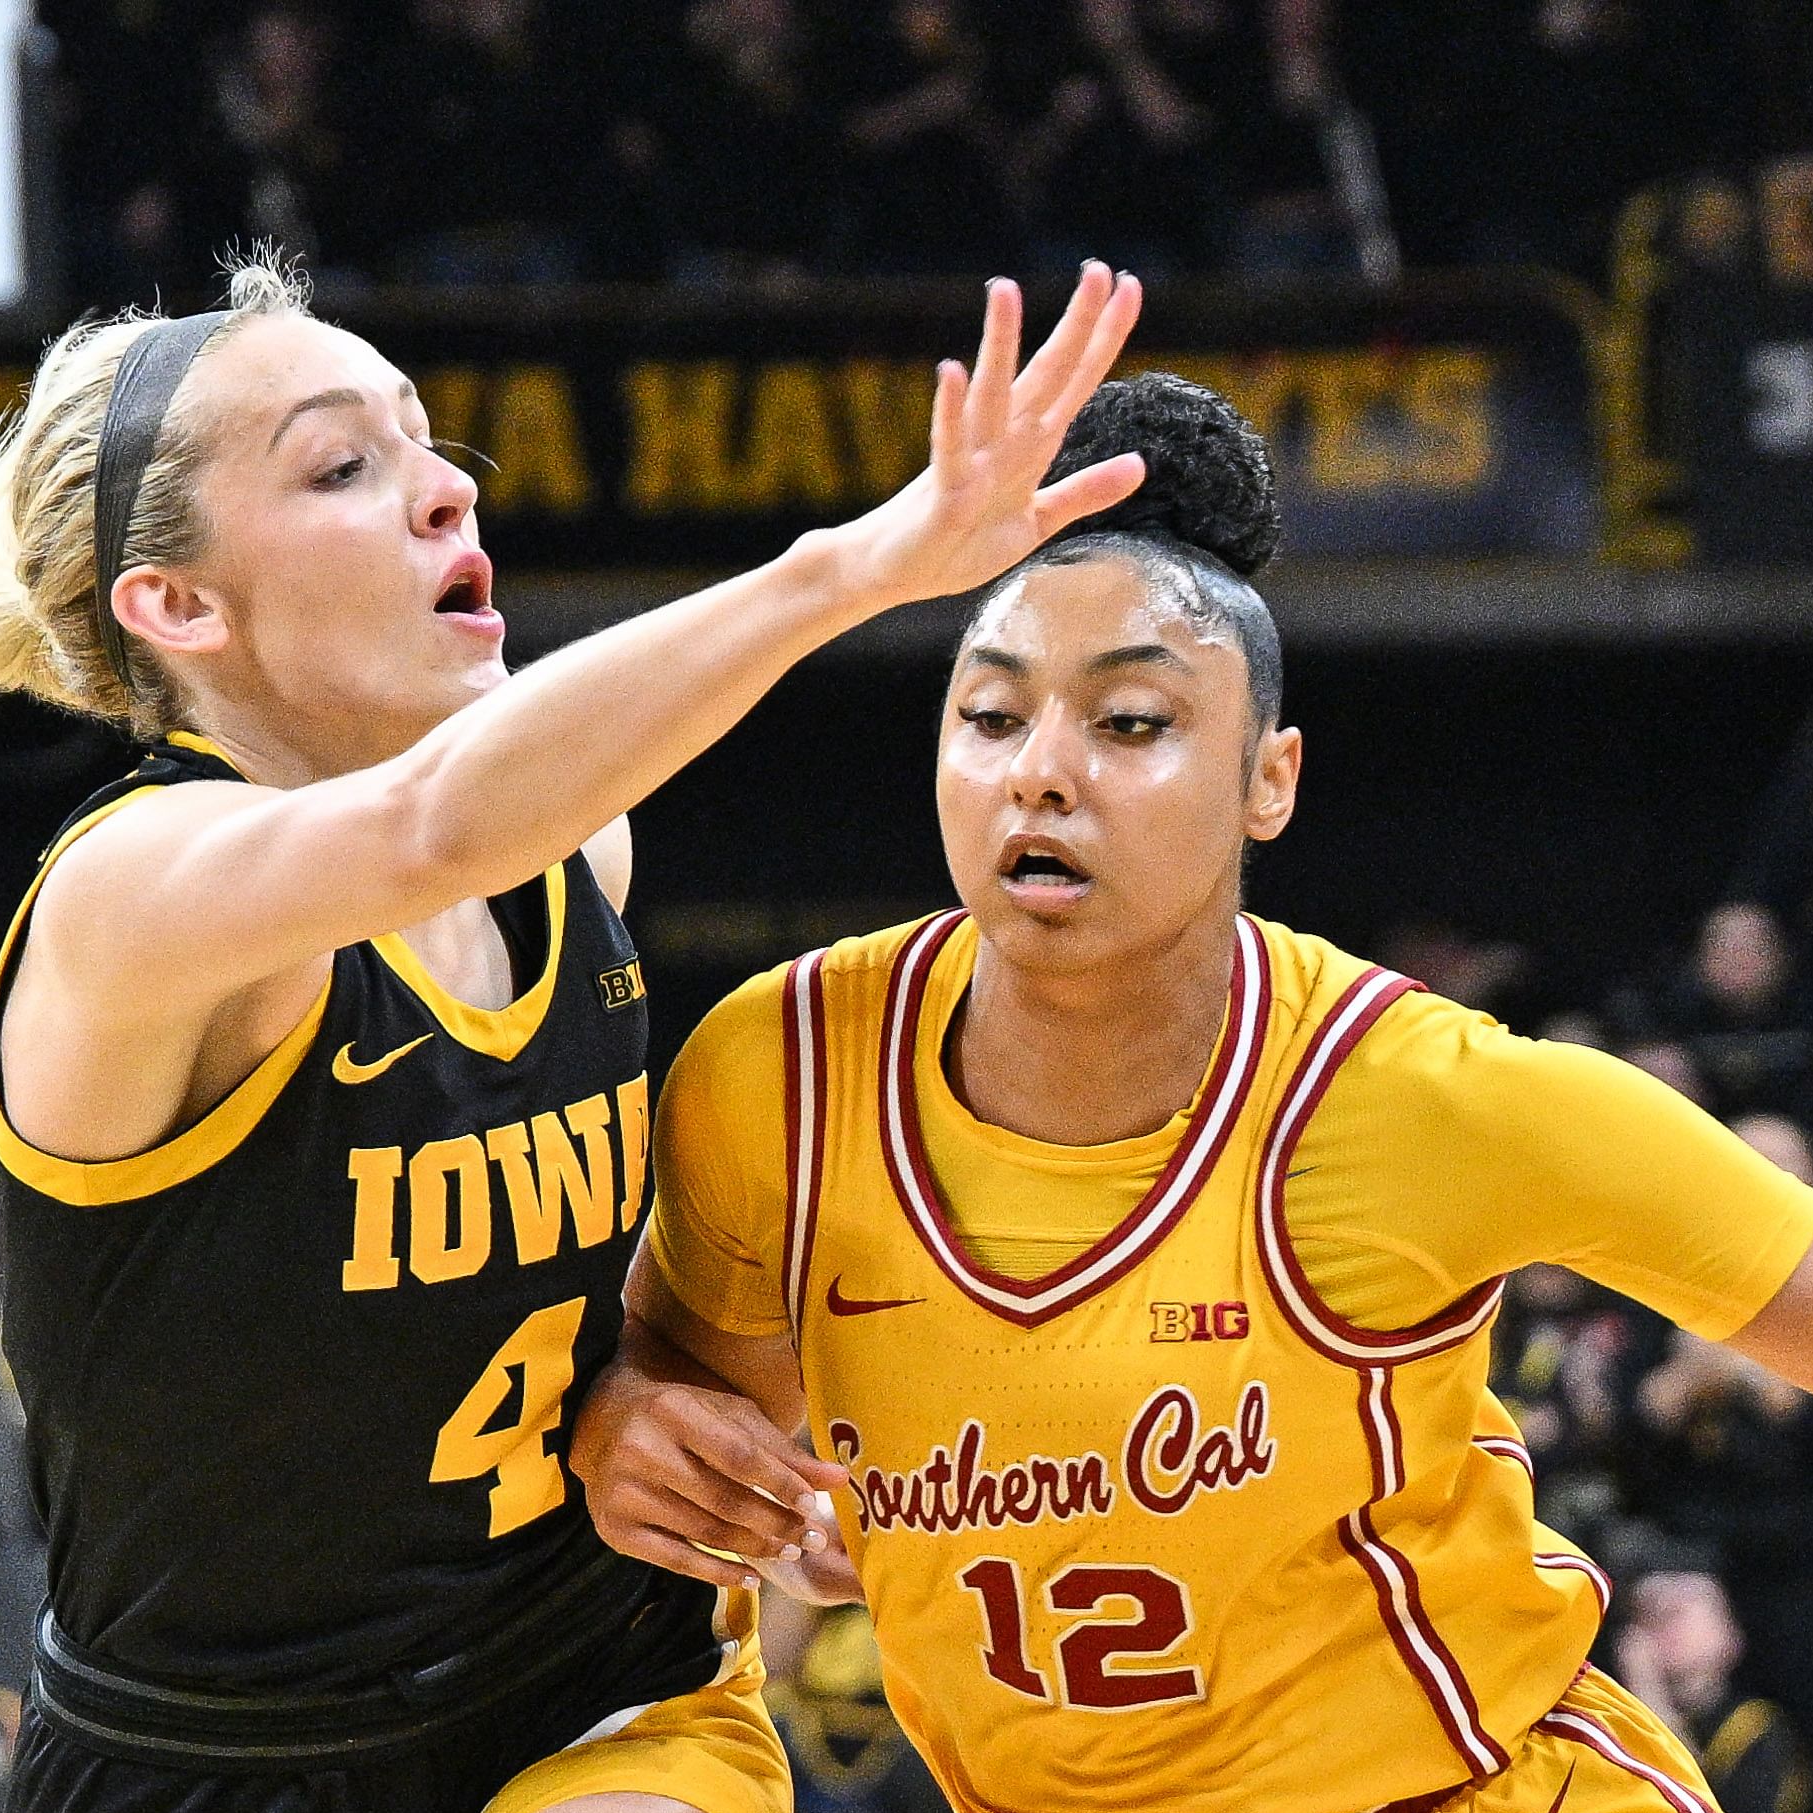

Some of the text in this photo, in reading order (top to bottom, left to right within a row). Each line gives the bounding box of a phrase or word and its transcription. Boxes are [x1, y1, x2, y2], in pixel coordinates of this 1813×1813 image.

[429, 1295, 587, 1540] 4
[1125, 1379, 1278, 1517] Cal
[955, 1554, 1206, 1713] 12
